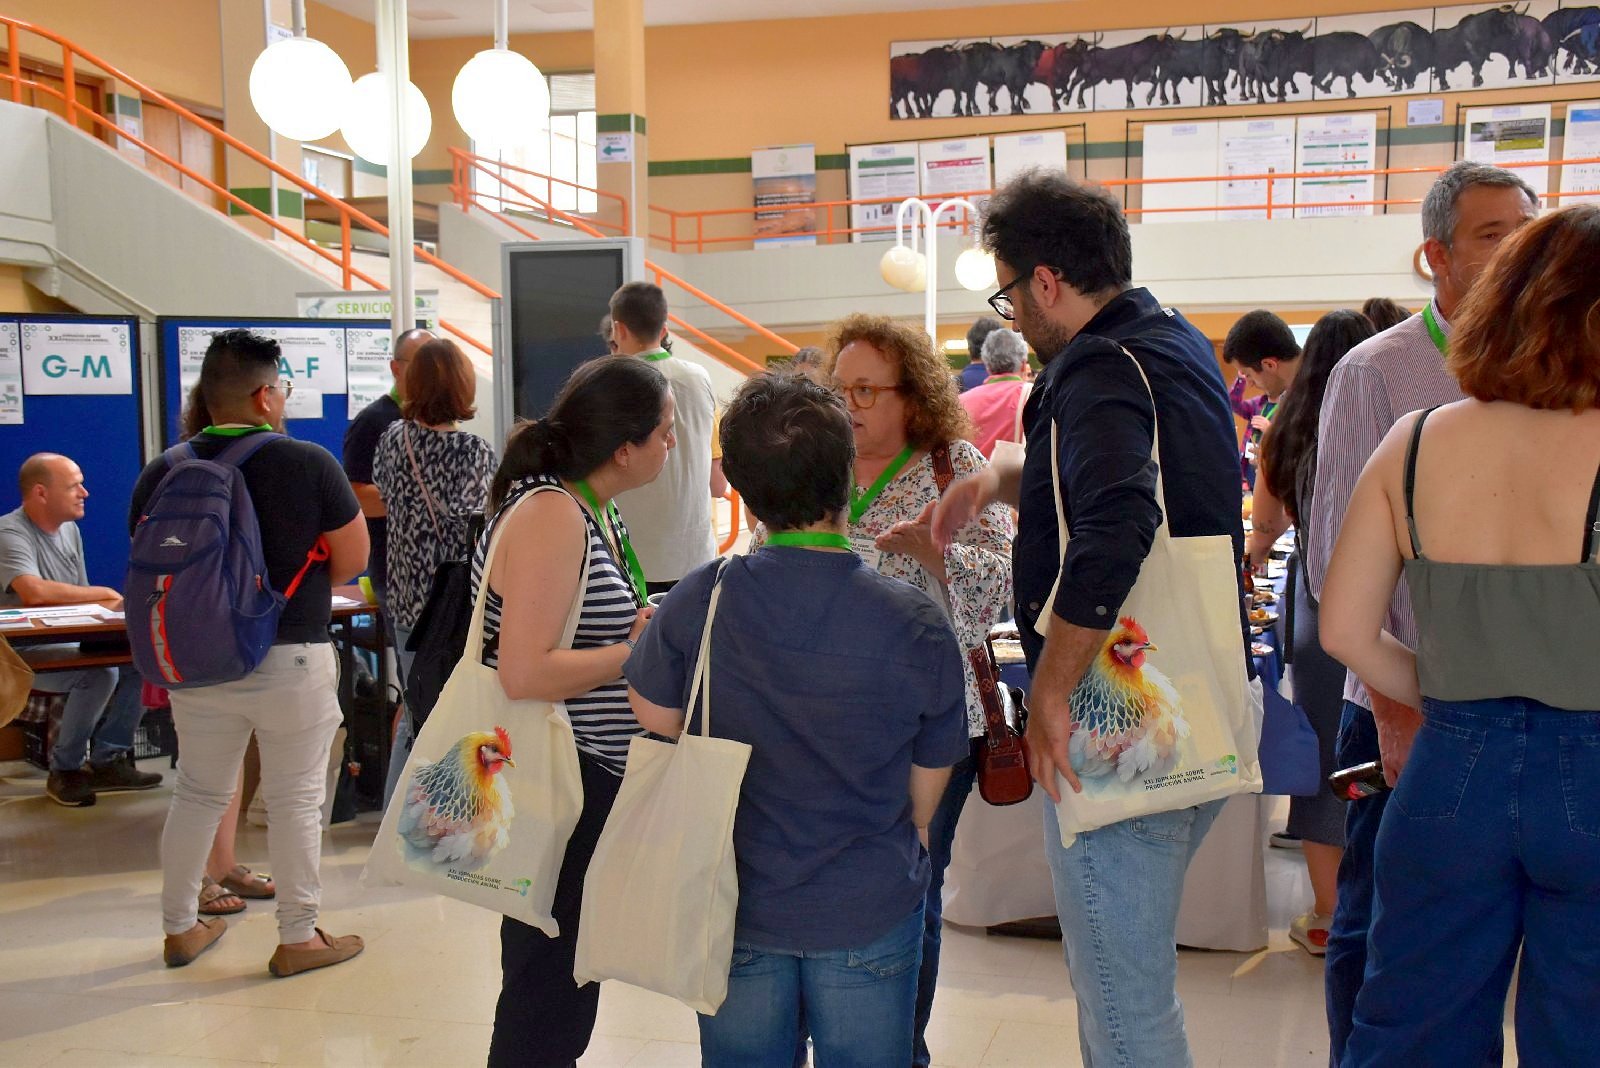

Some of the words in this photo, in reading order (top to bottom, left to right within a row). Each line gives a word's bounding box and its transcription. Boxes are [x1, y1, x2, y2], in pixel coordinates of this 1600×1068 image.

[42, 354, 112, 378] G-M
[278, 357, 319, 378] A-F
[1155, 772, 1184, 783] JORNADAS
[1185, 768, 1205, 777] SOBRE
[1183, 775, 1206, 784] ANIMAL
